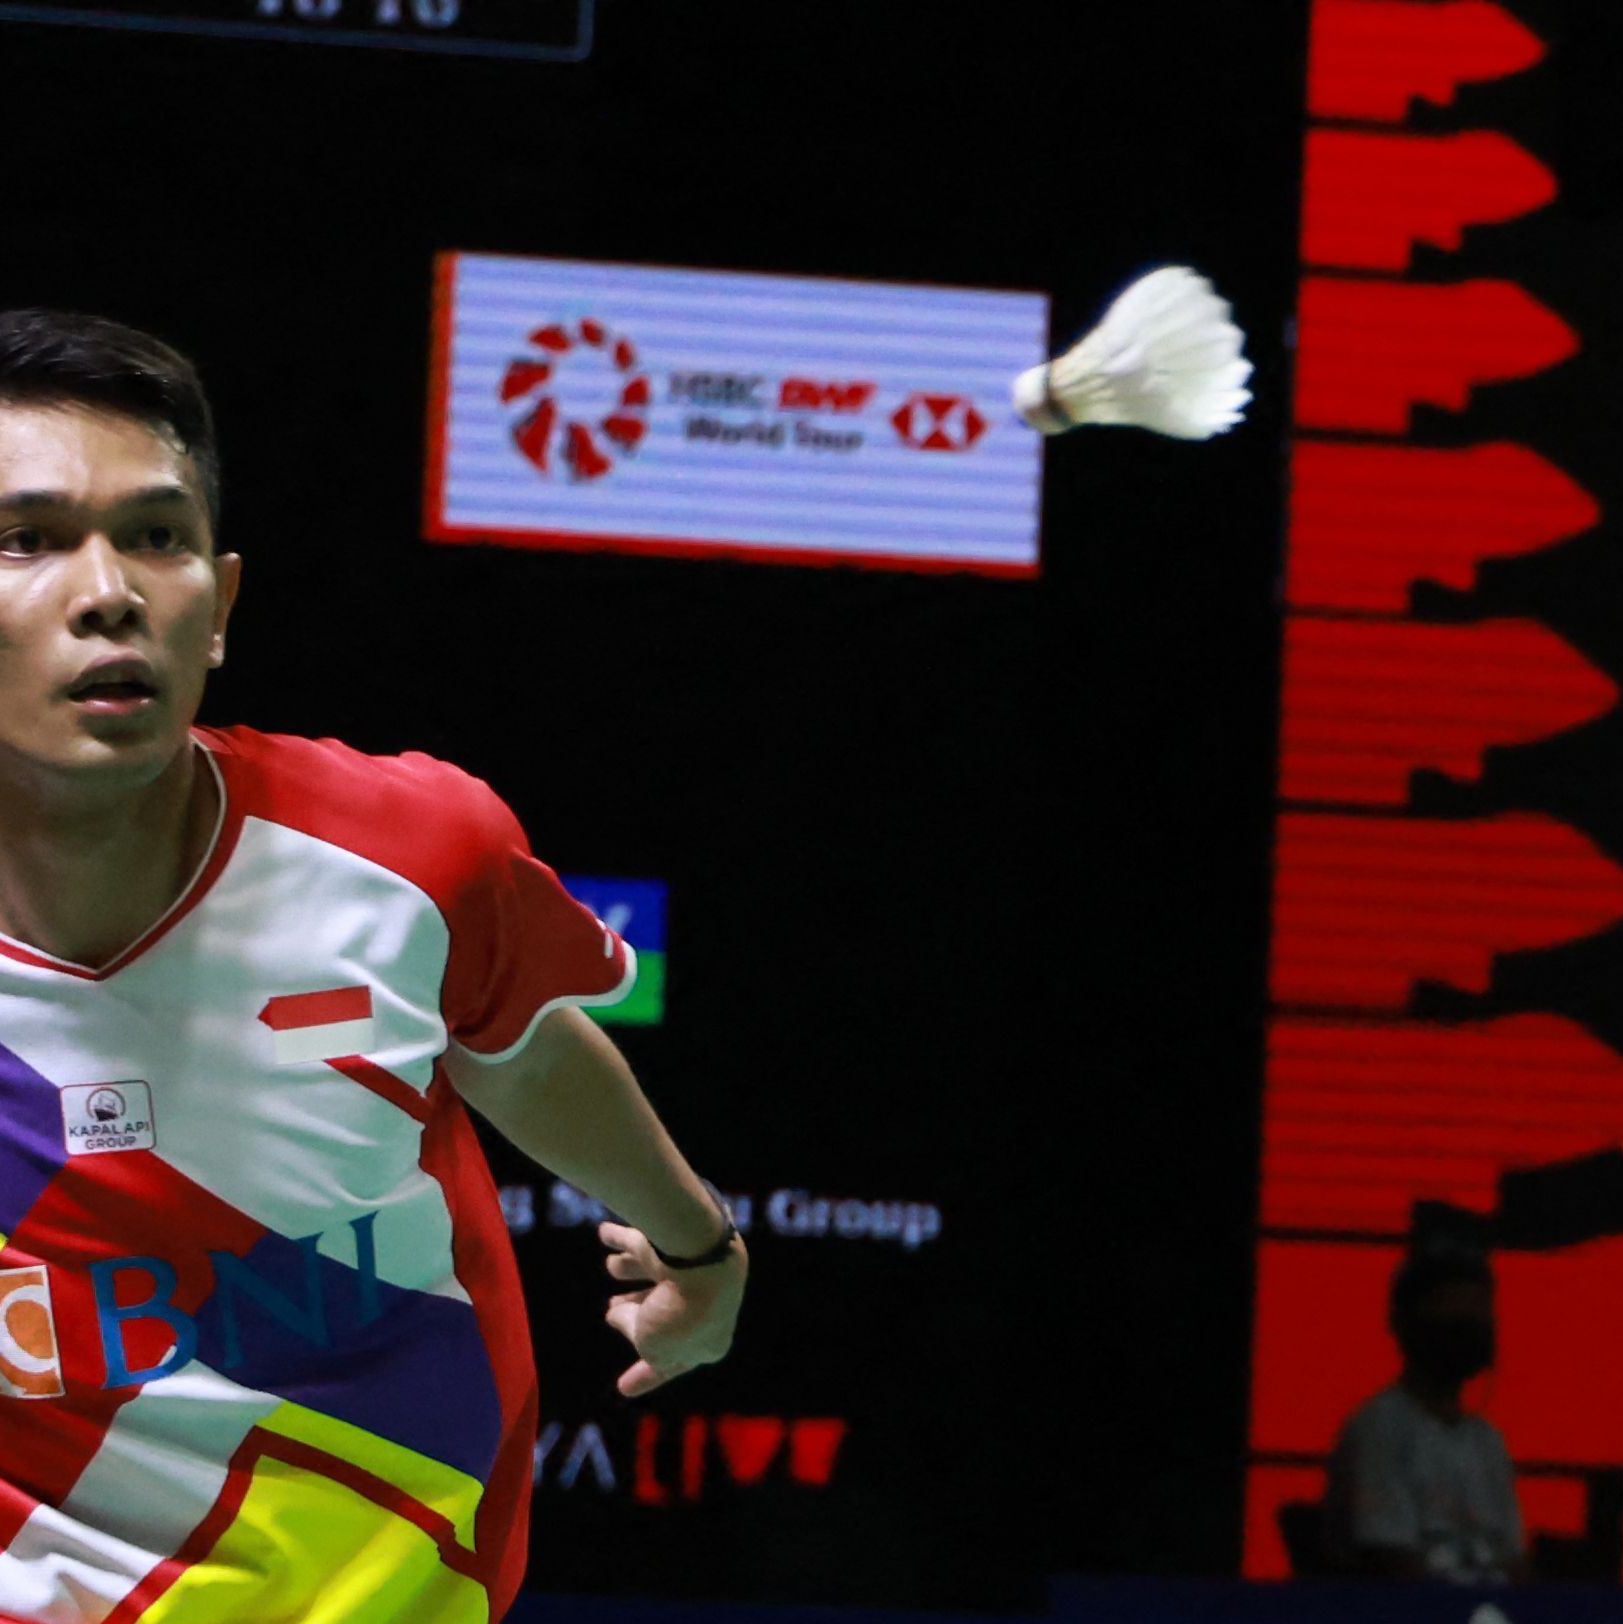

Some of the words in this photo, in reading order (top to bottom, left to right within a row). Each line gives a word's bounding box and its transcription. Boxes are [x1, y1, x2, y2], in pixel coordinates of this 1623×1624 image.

[68, 1123, 122, 1137] KAPAL
[124, 1121, 150, 1134] API
[84, 1135, 137, 1150] GROUP
[767, 1189, 942, 1246] Group
[89, 1209, 380, 1389] BNI
